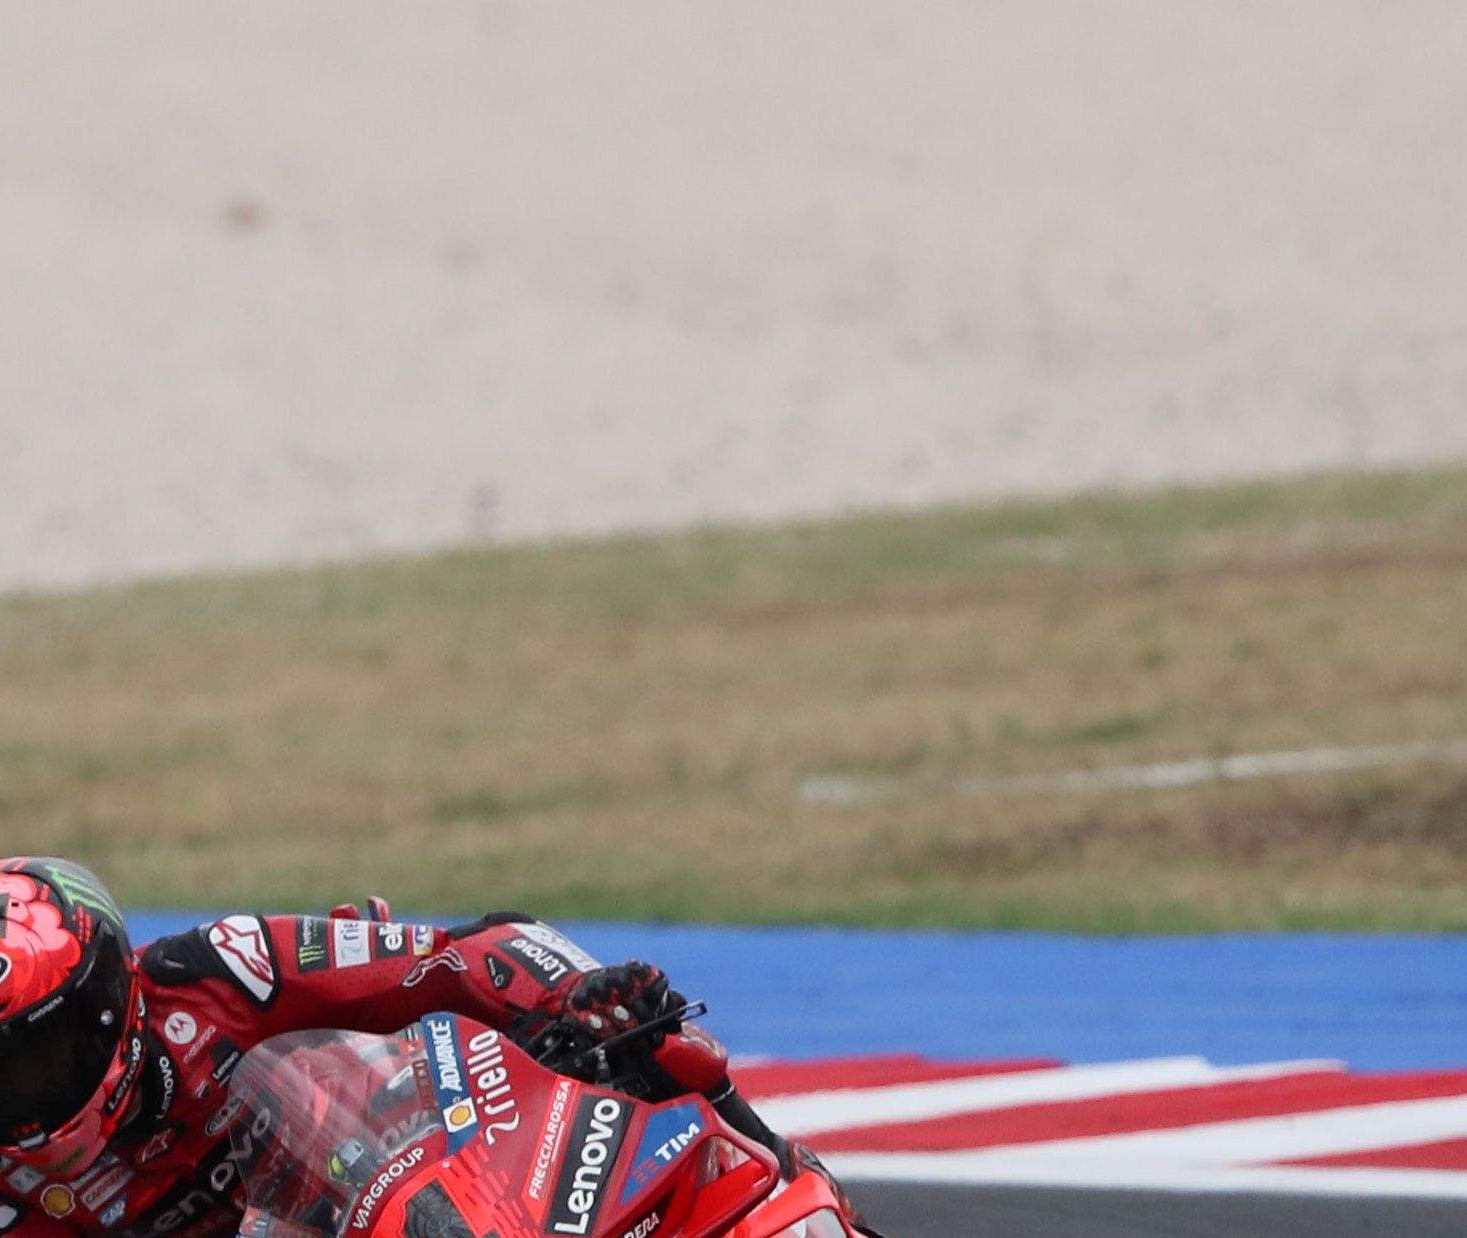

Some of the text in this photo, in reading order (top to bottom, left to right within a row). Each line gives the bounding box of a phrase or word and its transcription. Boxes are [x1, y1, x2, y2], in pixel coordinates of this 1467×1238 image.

[508, 938, 568, 983] Lenovo
[106, 1037, 142, 1112] Lenovo
[212, 1050, 239, 1080] Lenovo
[427, 1019, 463, 1093] ADVANCE
[527, 1080, 572, 1201] FRECCIAROSSA
[554, 1098, 622, 1235] Lenovo
[654, 1121, 701, 1163] TIM
[352, 1146, 425, 1231] VARGROUP
